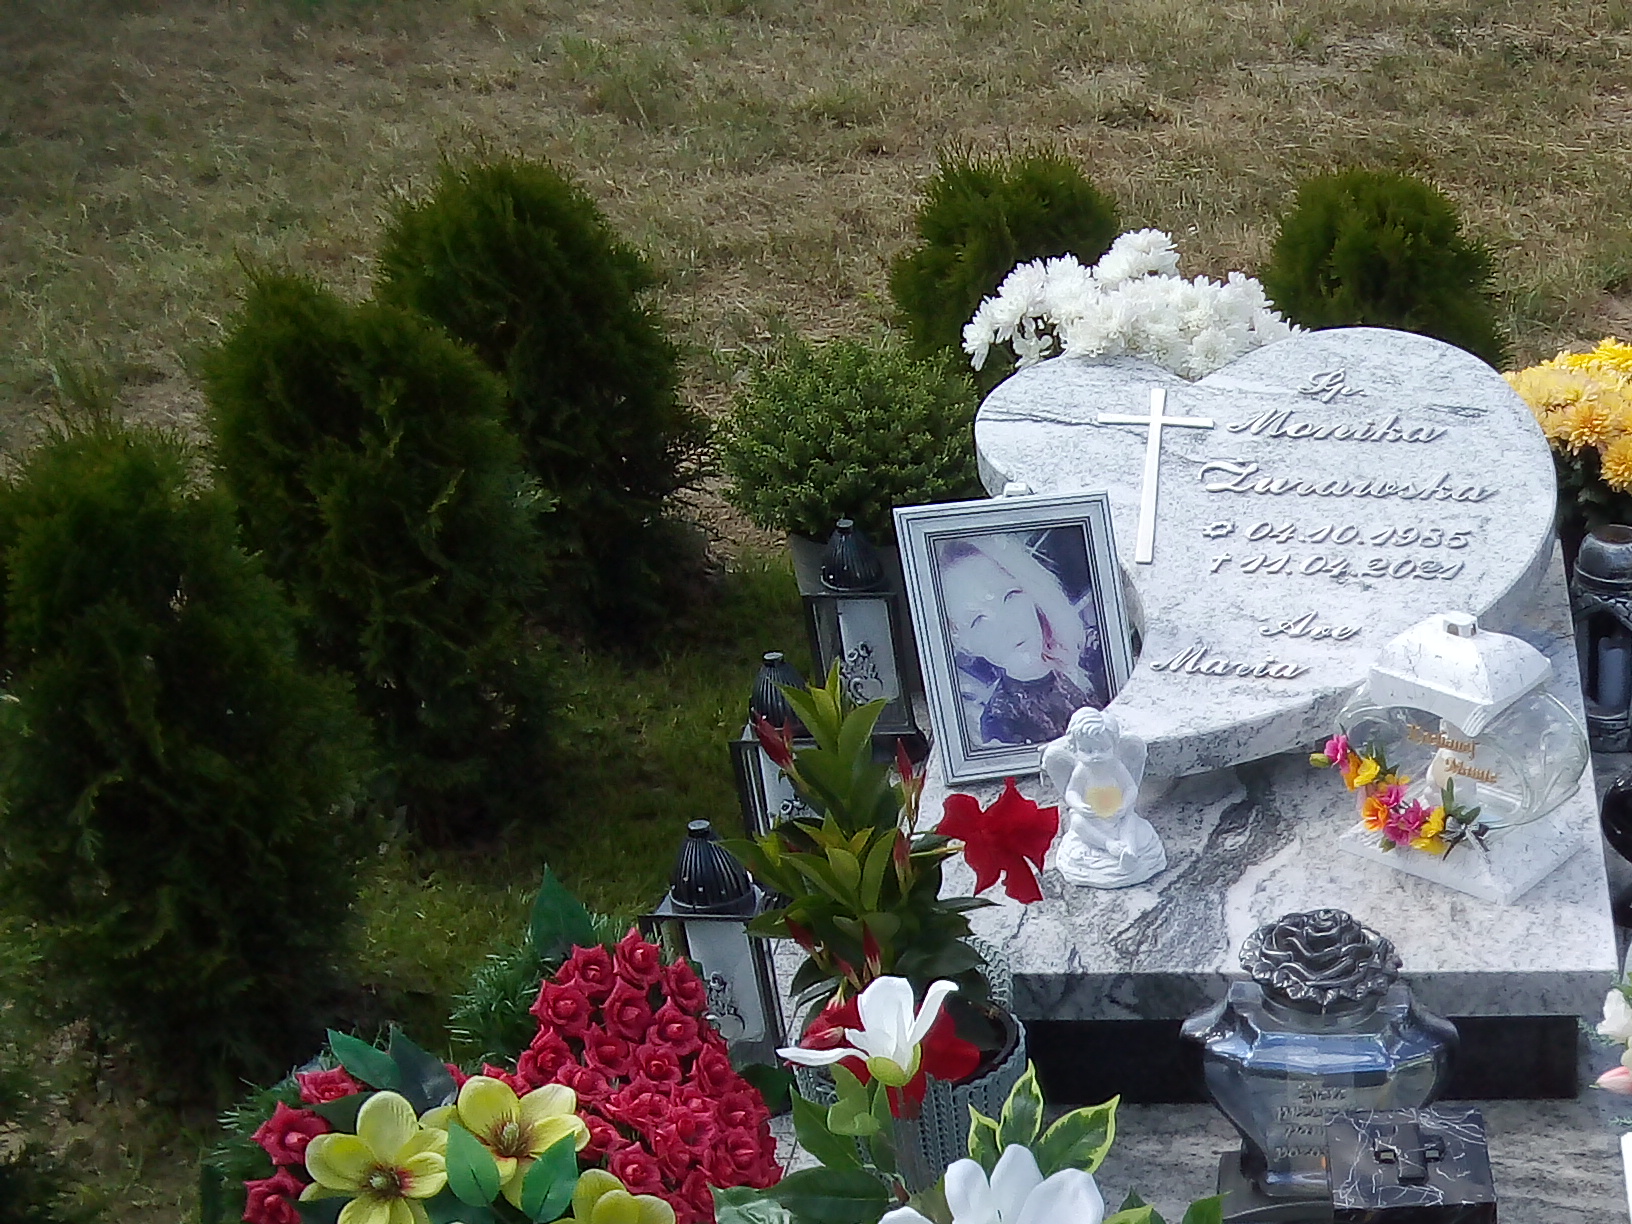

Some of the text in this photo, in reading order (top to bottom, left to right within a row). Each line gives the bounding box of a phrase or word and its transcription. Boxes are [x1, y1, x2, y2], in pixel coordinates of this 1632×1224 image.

[1226, 408, 1448, 443] Monika
[1240, 552, 1466, 581] 11.04.2021
[1258, 610, 1362, 641] Ave
[1149, 644, 1311, 679] Maria
